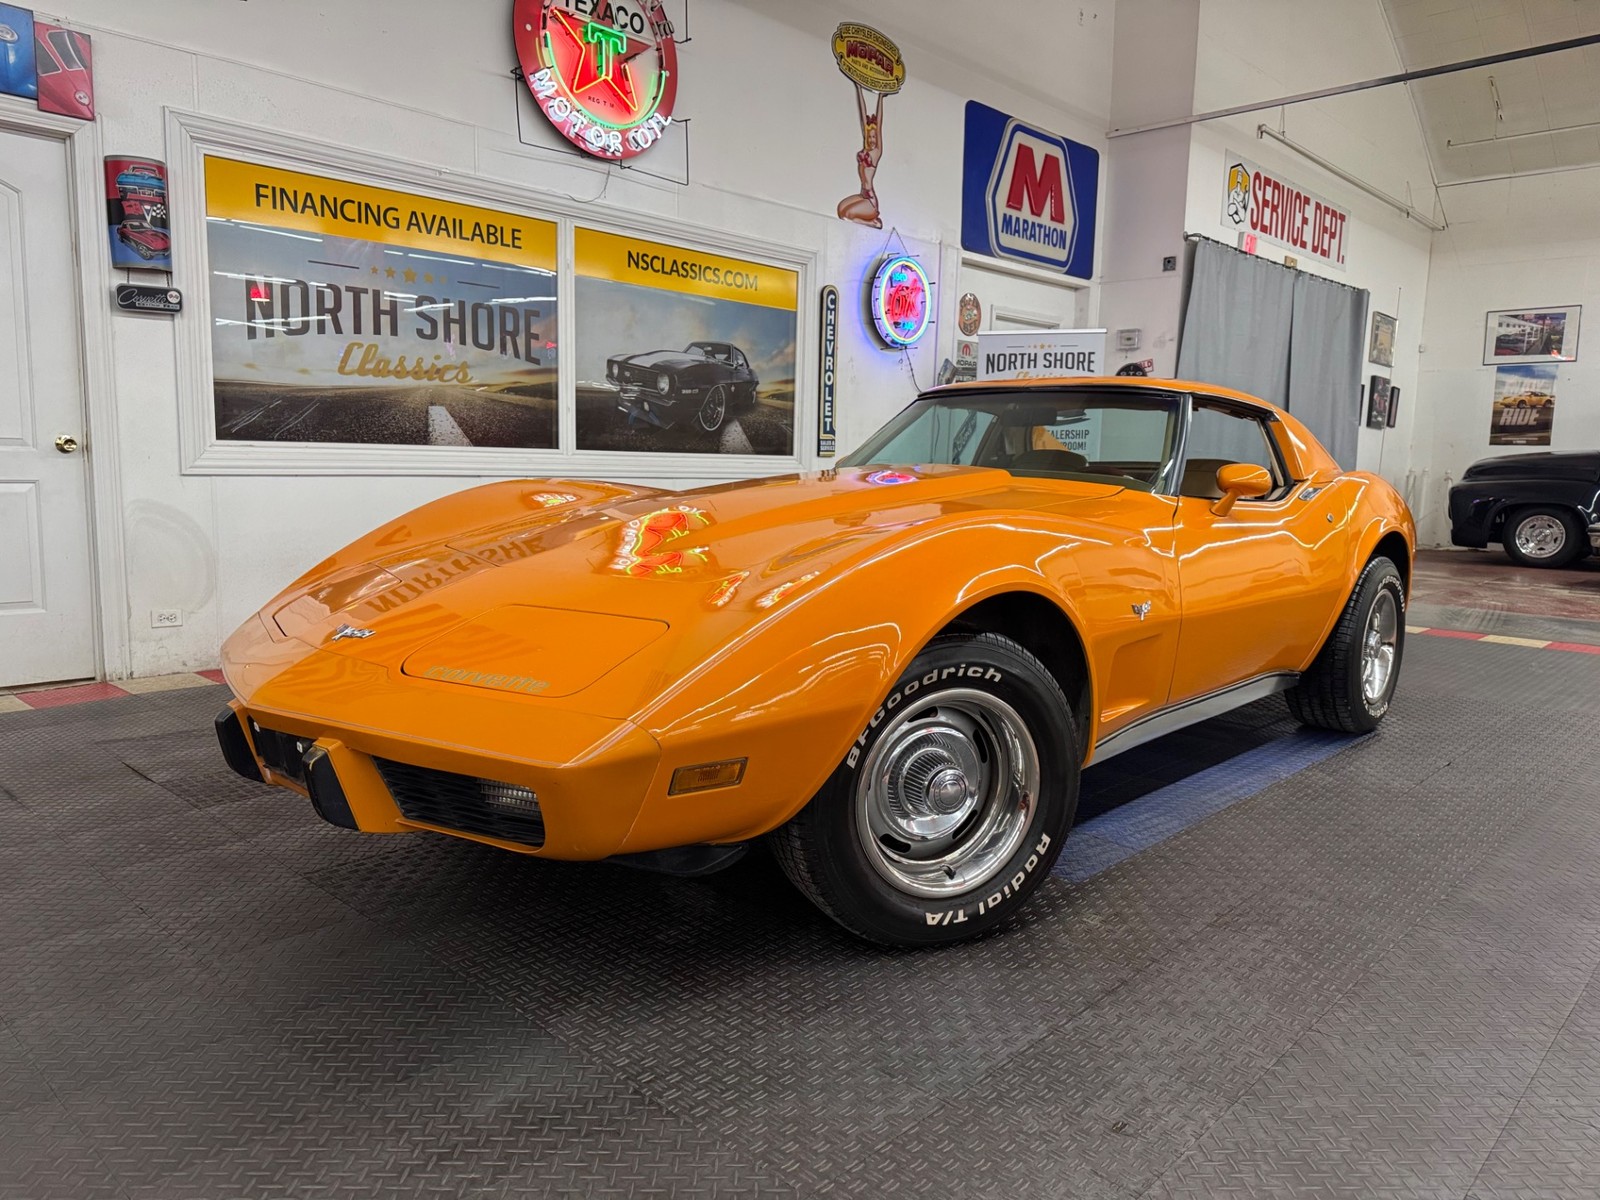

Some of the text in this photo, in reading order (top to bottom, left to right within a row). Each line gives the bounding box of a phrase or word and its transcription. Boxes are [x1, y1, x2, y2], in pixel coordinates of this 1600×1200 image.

[846, 40, 894, 78] MOPAR
[529, 69, 623, 156] MOTOR
[627, 112, 672, 151] OIL
[254, 183, 523, 250] FINANCING AVAILABLE
[1006, 143, 1065, 225] M
[1001, 213, 1067, 250] MARATHON
[1250, 171, 1346, 265] SERVICE DEPT.
[118, 288, 167, 305] Corvette
[627, 250, 758, 292] NSCLASSICS.COM
[245, 272, 541, 366] NORTH SHORE
[337, 341, 474, 384] Classics
[825, 294, 835, 432] CHEVROLET
[985, 351, 1096, 375] NORTH SHORE
[1499, 408, 1540, 426] RIDE
[846, 664, 1002, 770] BFGoodrich
[925, 833, 1052, 926] Radial T/A
